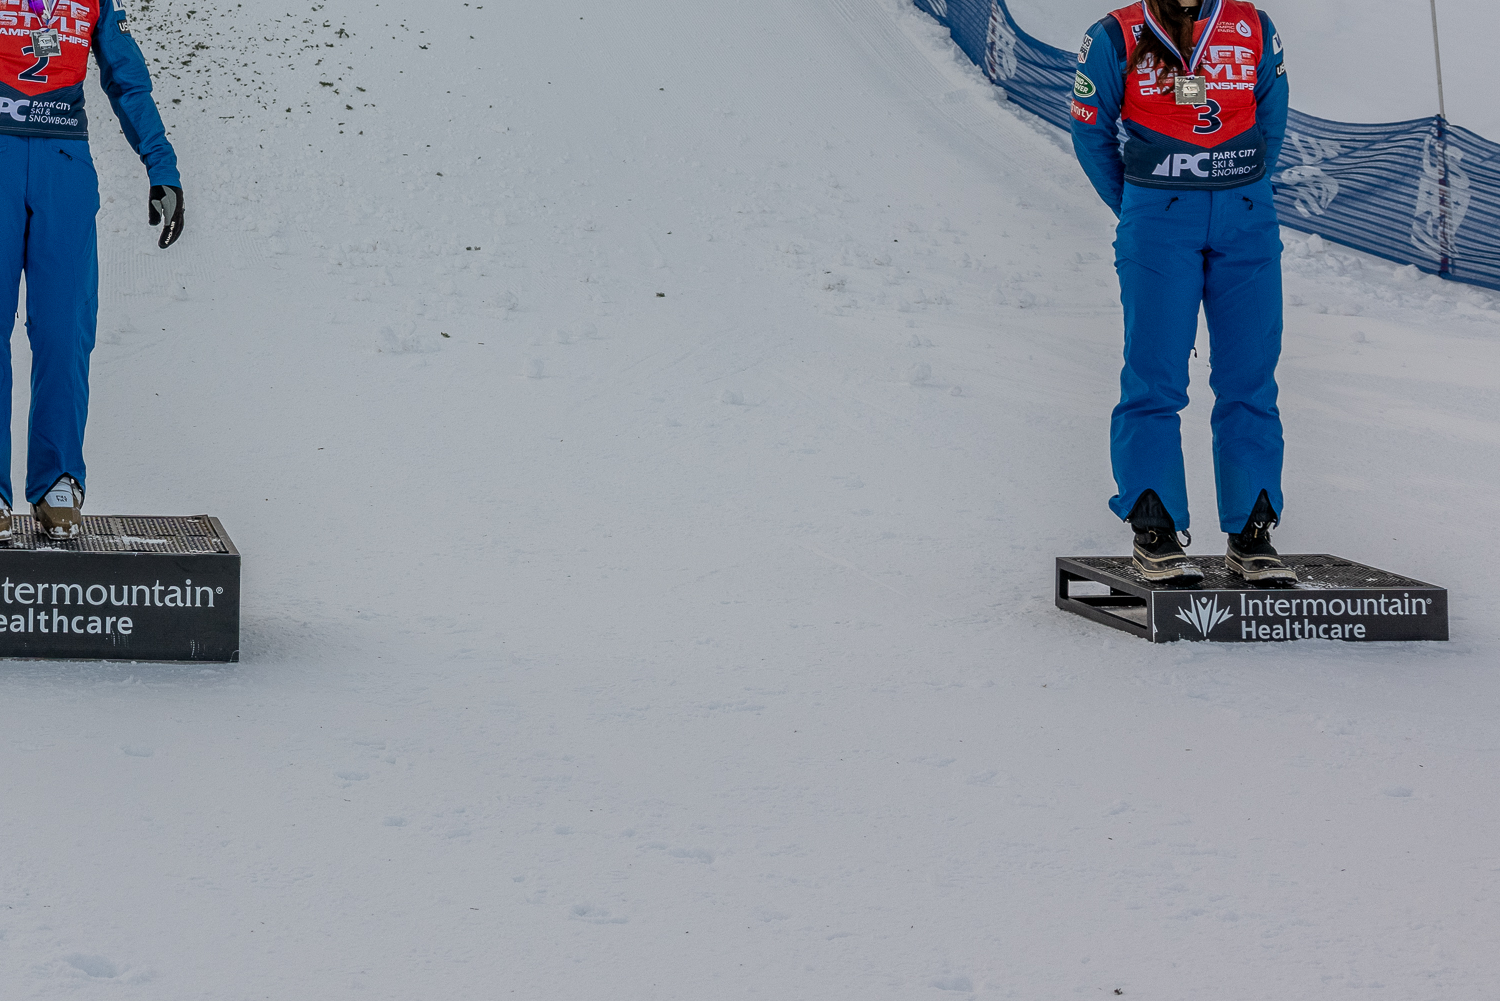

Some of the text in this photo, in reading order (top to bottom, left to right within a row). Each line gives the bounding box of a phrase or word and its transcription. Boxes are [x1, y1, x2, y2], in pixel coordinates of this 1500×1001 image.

[18, 45, 49, 83] 2
[32, 100, 56, 109] PARK
[45, 108, 51, 116] &
[1192, 98, 1222, 134] 3
[29, 115, 78, 126] SNOWBOARD
[1212, 148, 1256, 160] PARK CITY
[1212, 159, 1234, 169] SKI &
[1211, 164, 1257, 177] SNOWBO
[1241, 618, 1366, 640] Healthcare
